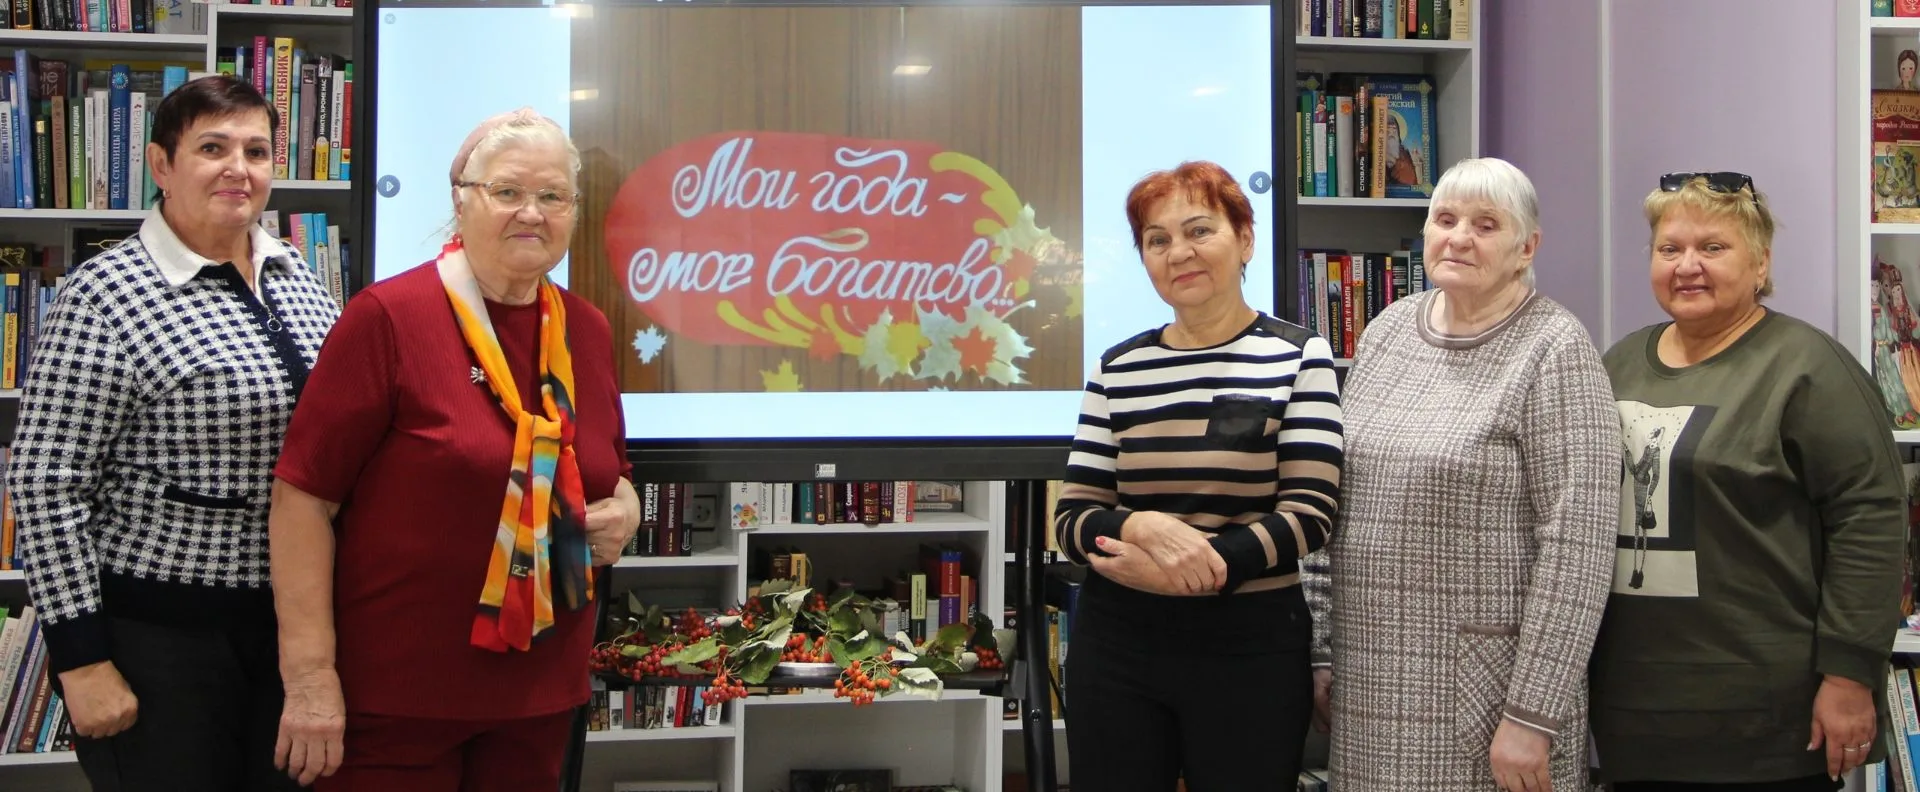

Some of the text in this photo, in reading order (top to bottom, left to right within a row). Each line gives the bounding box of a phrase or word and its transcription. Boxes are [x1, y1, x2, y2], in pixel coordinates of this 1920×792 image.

[276, 55, 289, 110] ЛЕЧЕБНИК
[319, 79, 328, 135] НИКТО, КРОМЕ НАС
[72, 105, 80, 135] МЕДИЦИНА
[111, 107, 121, 199] ВСЕ СТОЛИЦЫ МИРА
[672, 138, 799, 218] Мои
[809, 146, 928, 217] года
[628, 247, 754, 302] мое
[1331, 301, 1339, 353] НЕУДЕРЖИМЫЙ
